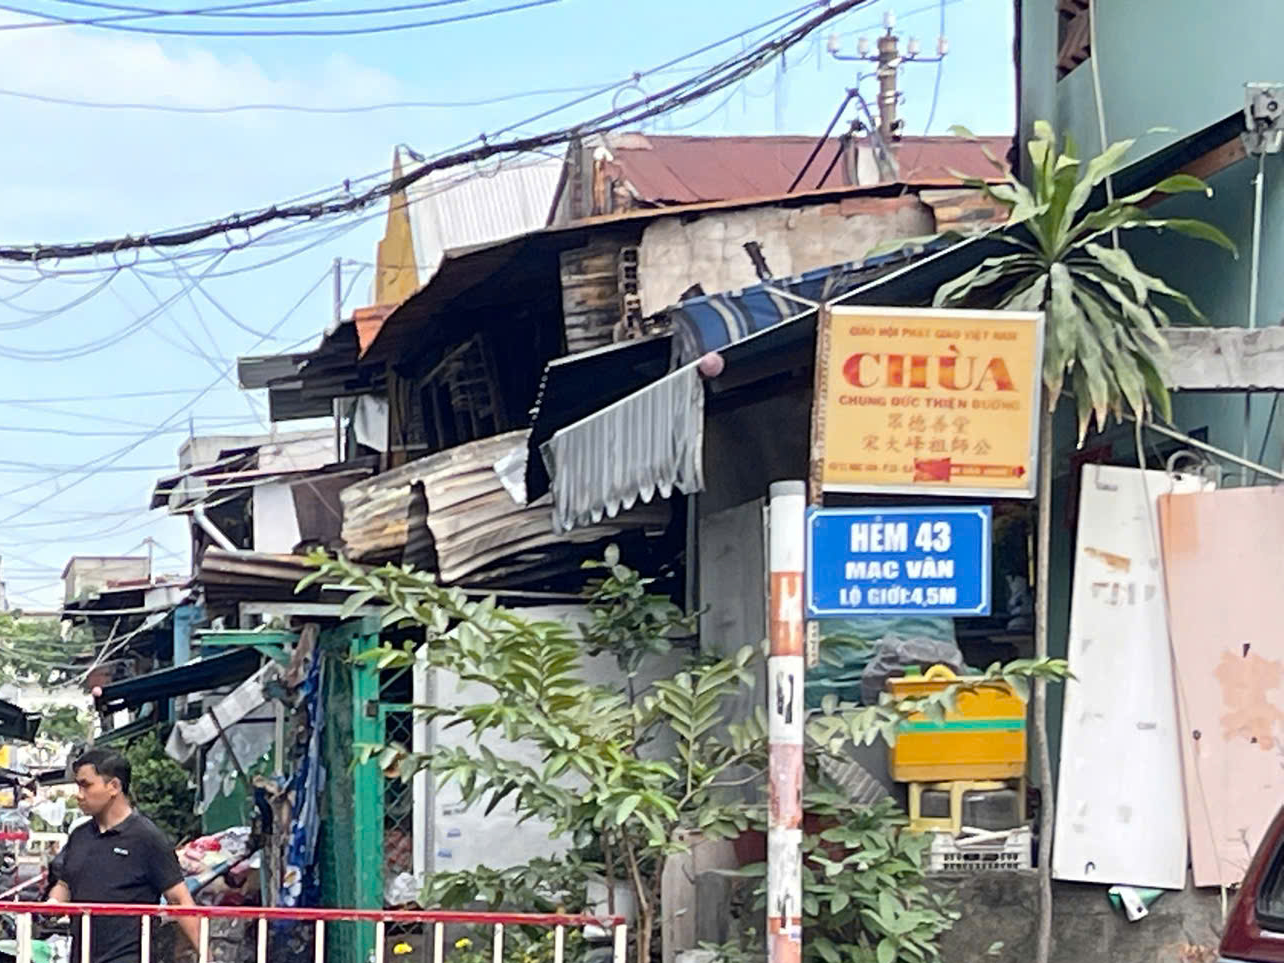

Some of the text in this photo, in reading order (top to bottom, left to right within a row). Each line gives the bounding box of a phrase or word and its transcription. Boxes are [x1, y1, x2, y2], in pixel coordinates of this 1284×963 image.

[842, 344, 1019, 392] CHÙA
[839, 394, 887, 407] CHUNG
[850, 516, 952, 553] HẺM 43
[845, 556, 955, 584] MẠC VÂN
[839, 585, 862, 608] LỘ
